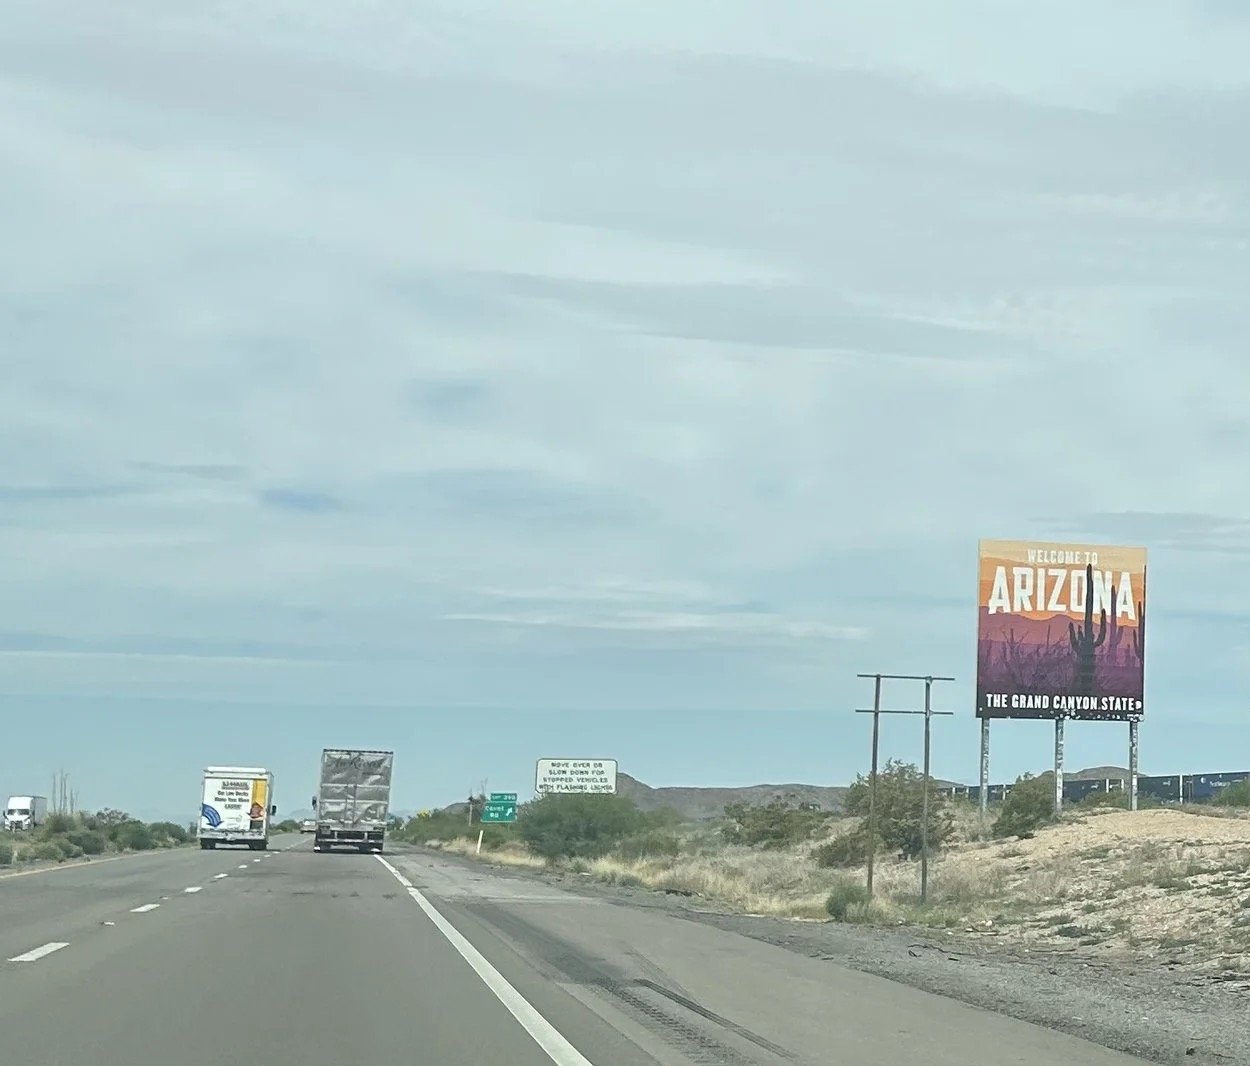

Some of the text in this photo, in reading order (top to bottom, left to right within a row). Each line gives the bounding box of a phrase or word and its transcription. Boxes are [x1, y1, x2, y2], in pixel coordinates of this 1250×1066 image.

[1027, 549, 1098, 566] WELCOME TO
[988, 565, 1136, 620] ARIZONA
[986, 693, 1135, 711] THE GRAND CANYON STATE
